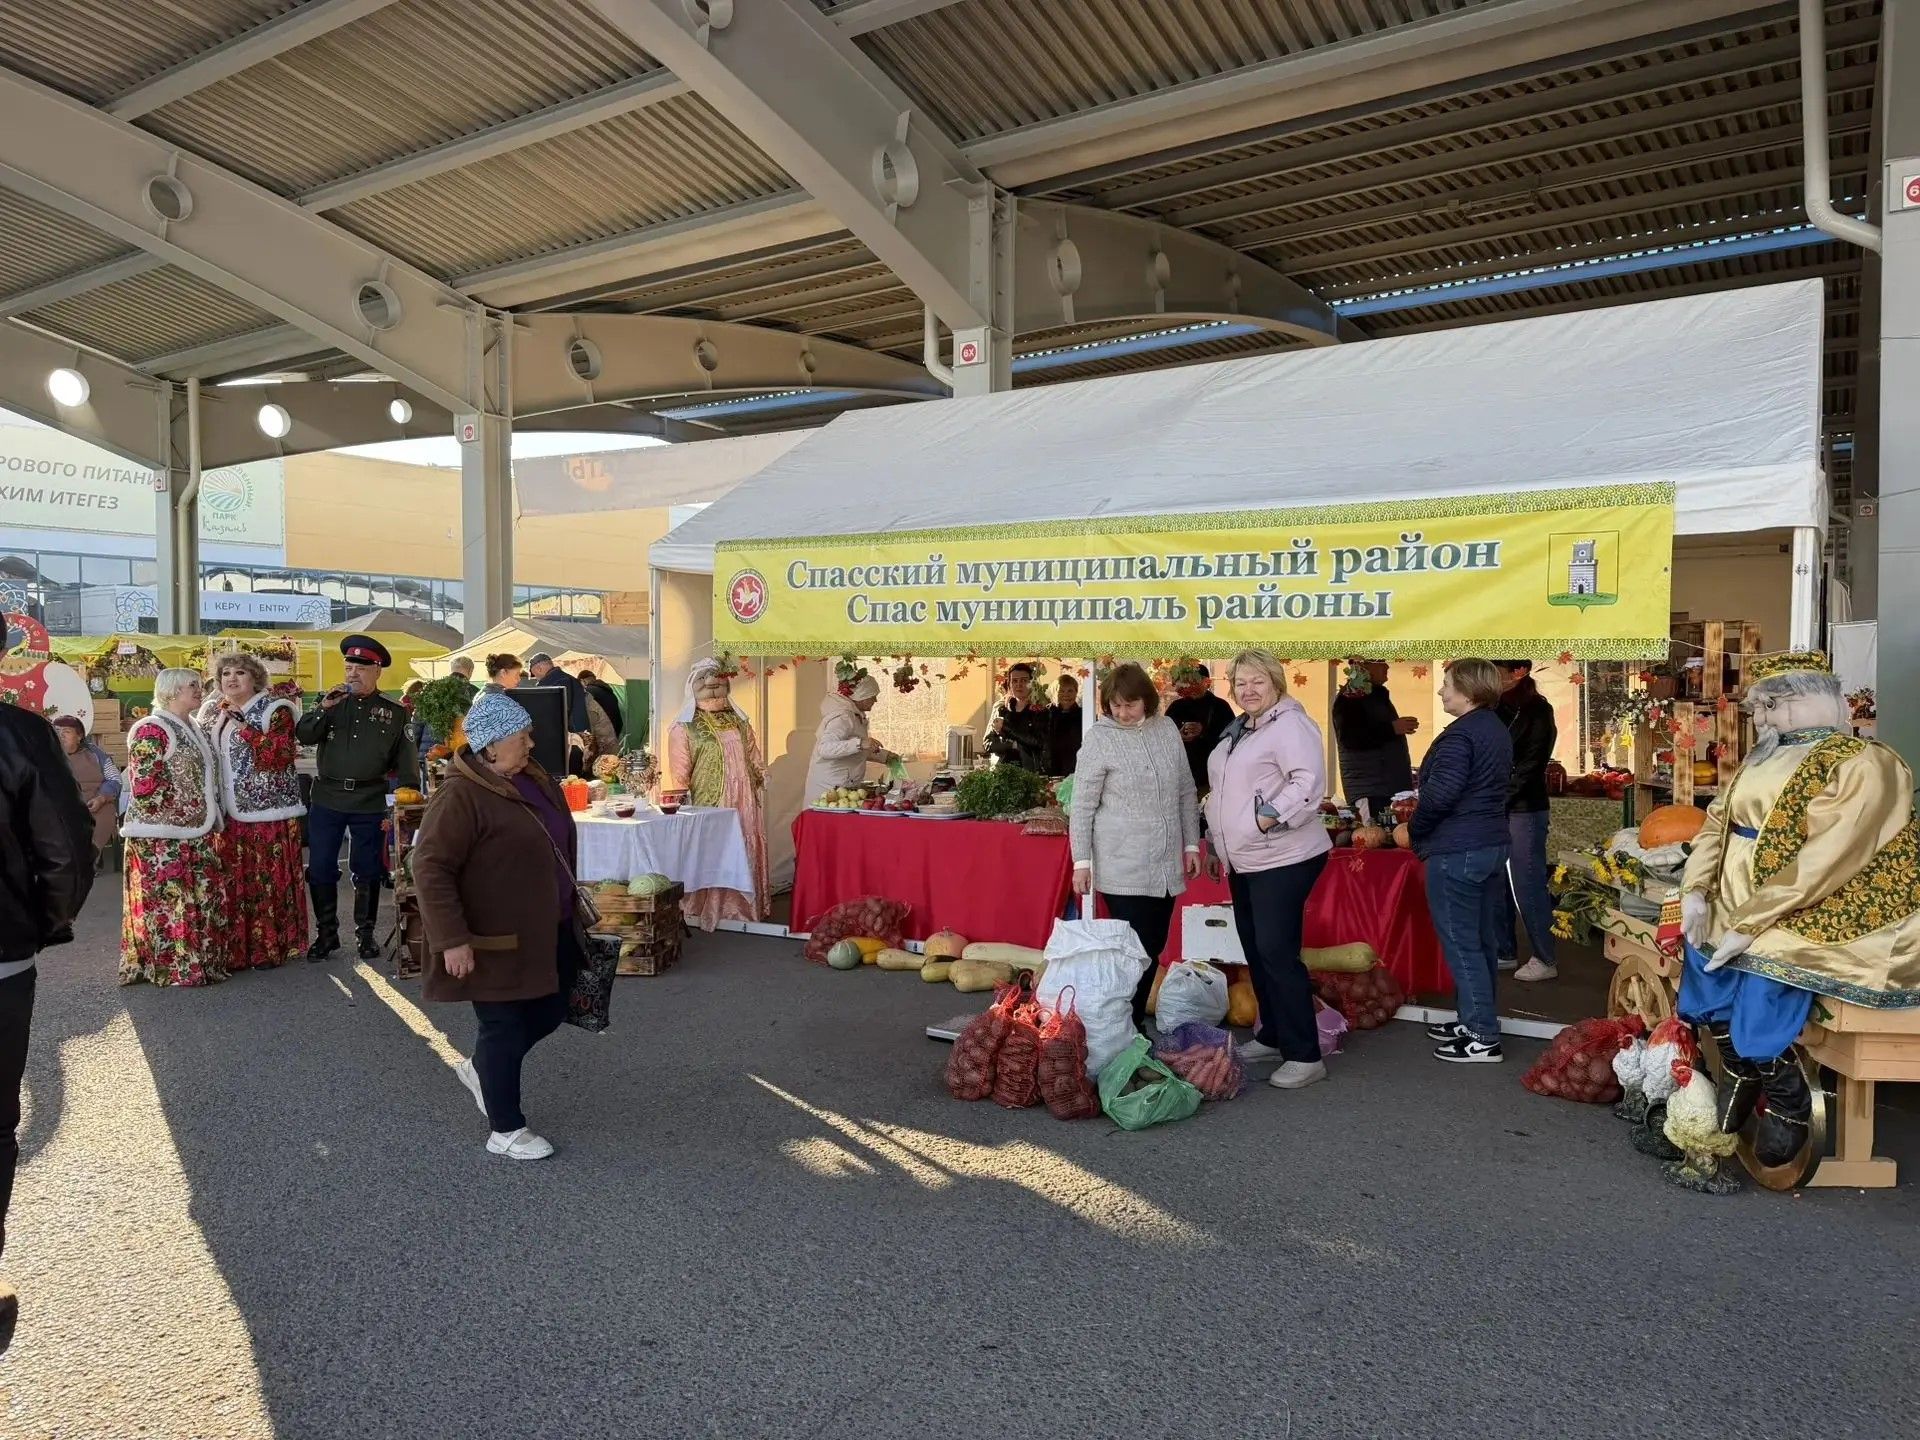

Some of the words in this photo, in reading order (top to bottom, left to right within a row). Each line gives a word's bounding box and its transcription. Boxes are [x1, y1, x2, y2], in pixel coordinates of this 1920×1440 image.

[50, 490, 119, 510] ИТЕГЕЗ
[787, 554, 946, 588] Спасский
[957, 538, 1317, 591] муниципальный
[1331, 532, 1500, 583] район
[259, 604, 290, 612] ENTRY
[847, 594, 927, 624] Спас
[936, 593, 1185, 630] муниципаль
[1197, 582, 1391, 630] районы
